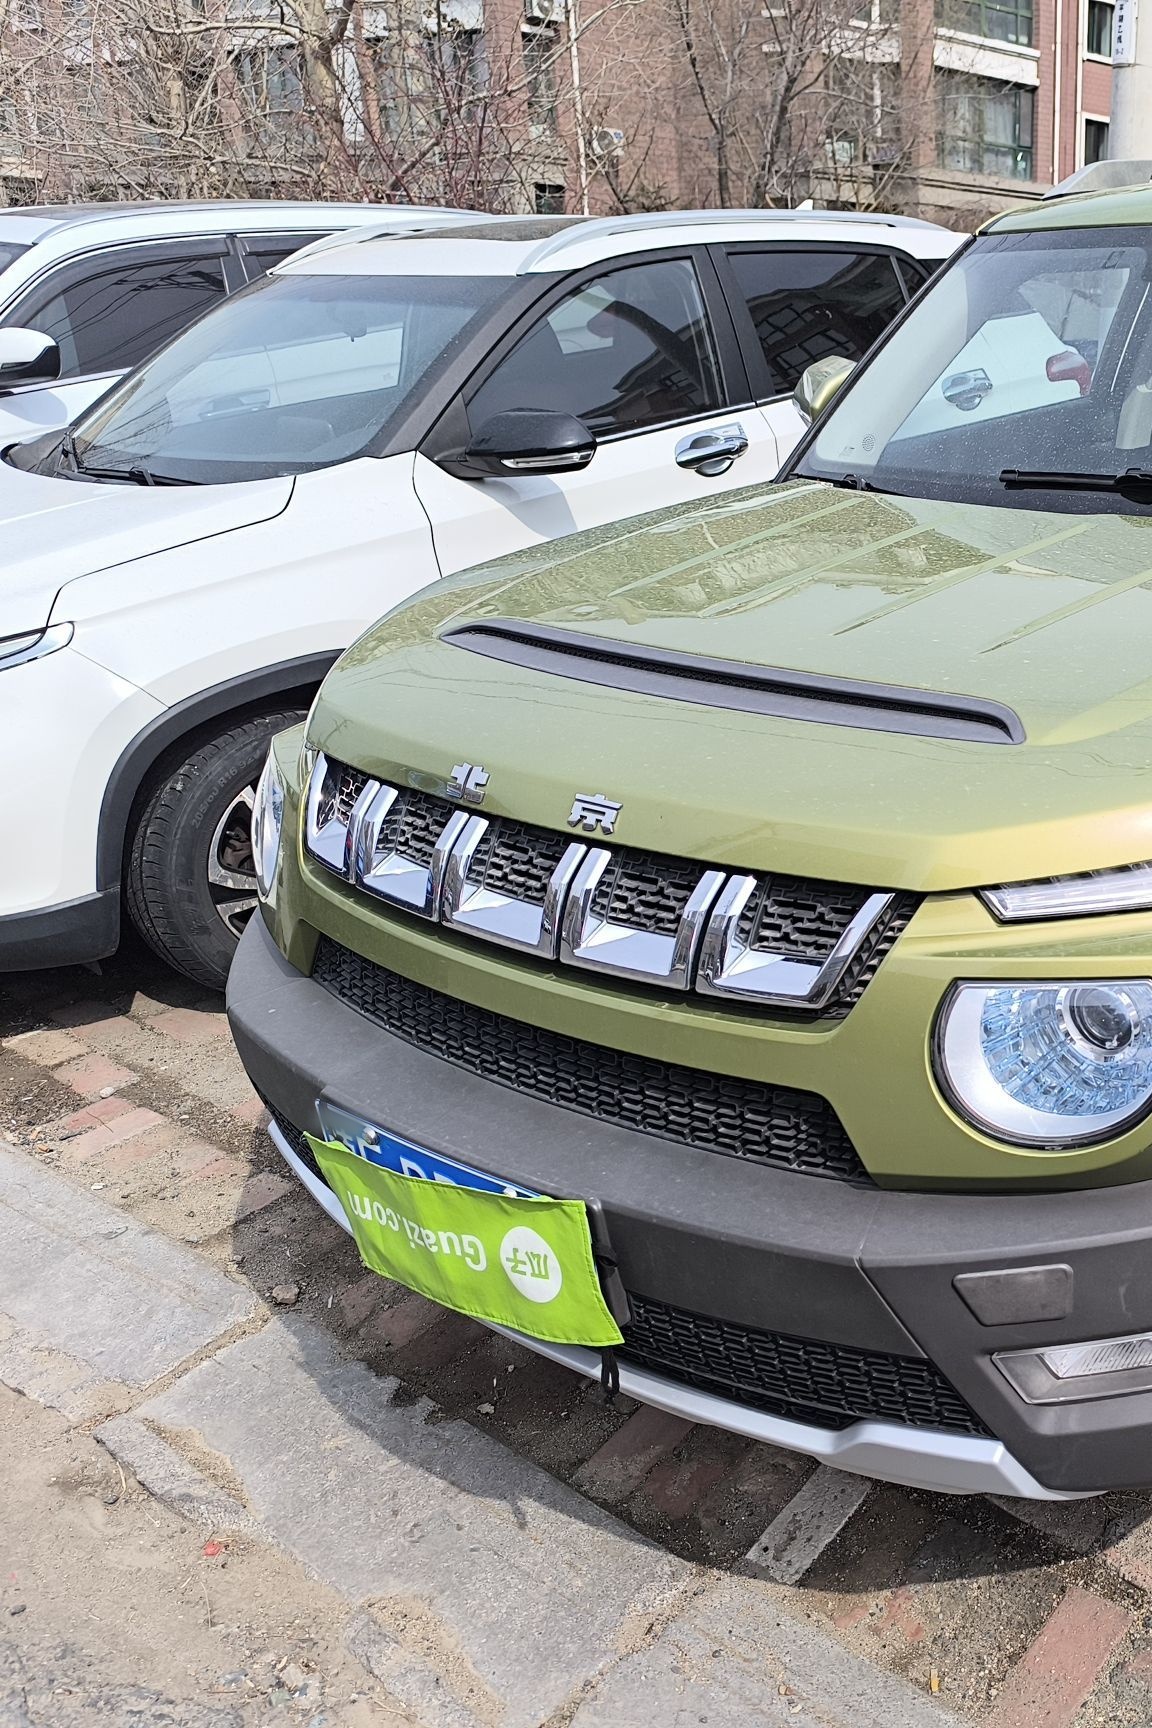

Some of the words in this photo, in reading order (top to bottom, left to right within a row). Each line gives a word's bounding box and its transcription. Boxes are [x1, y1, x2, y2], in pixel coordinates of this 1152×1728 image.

[446, 762, 623, 835] 北京
[348, 1190, 488, 1272] Guazi.com
[506, 1247, 549, 1280] 瓜子
